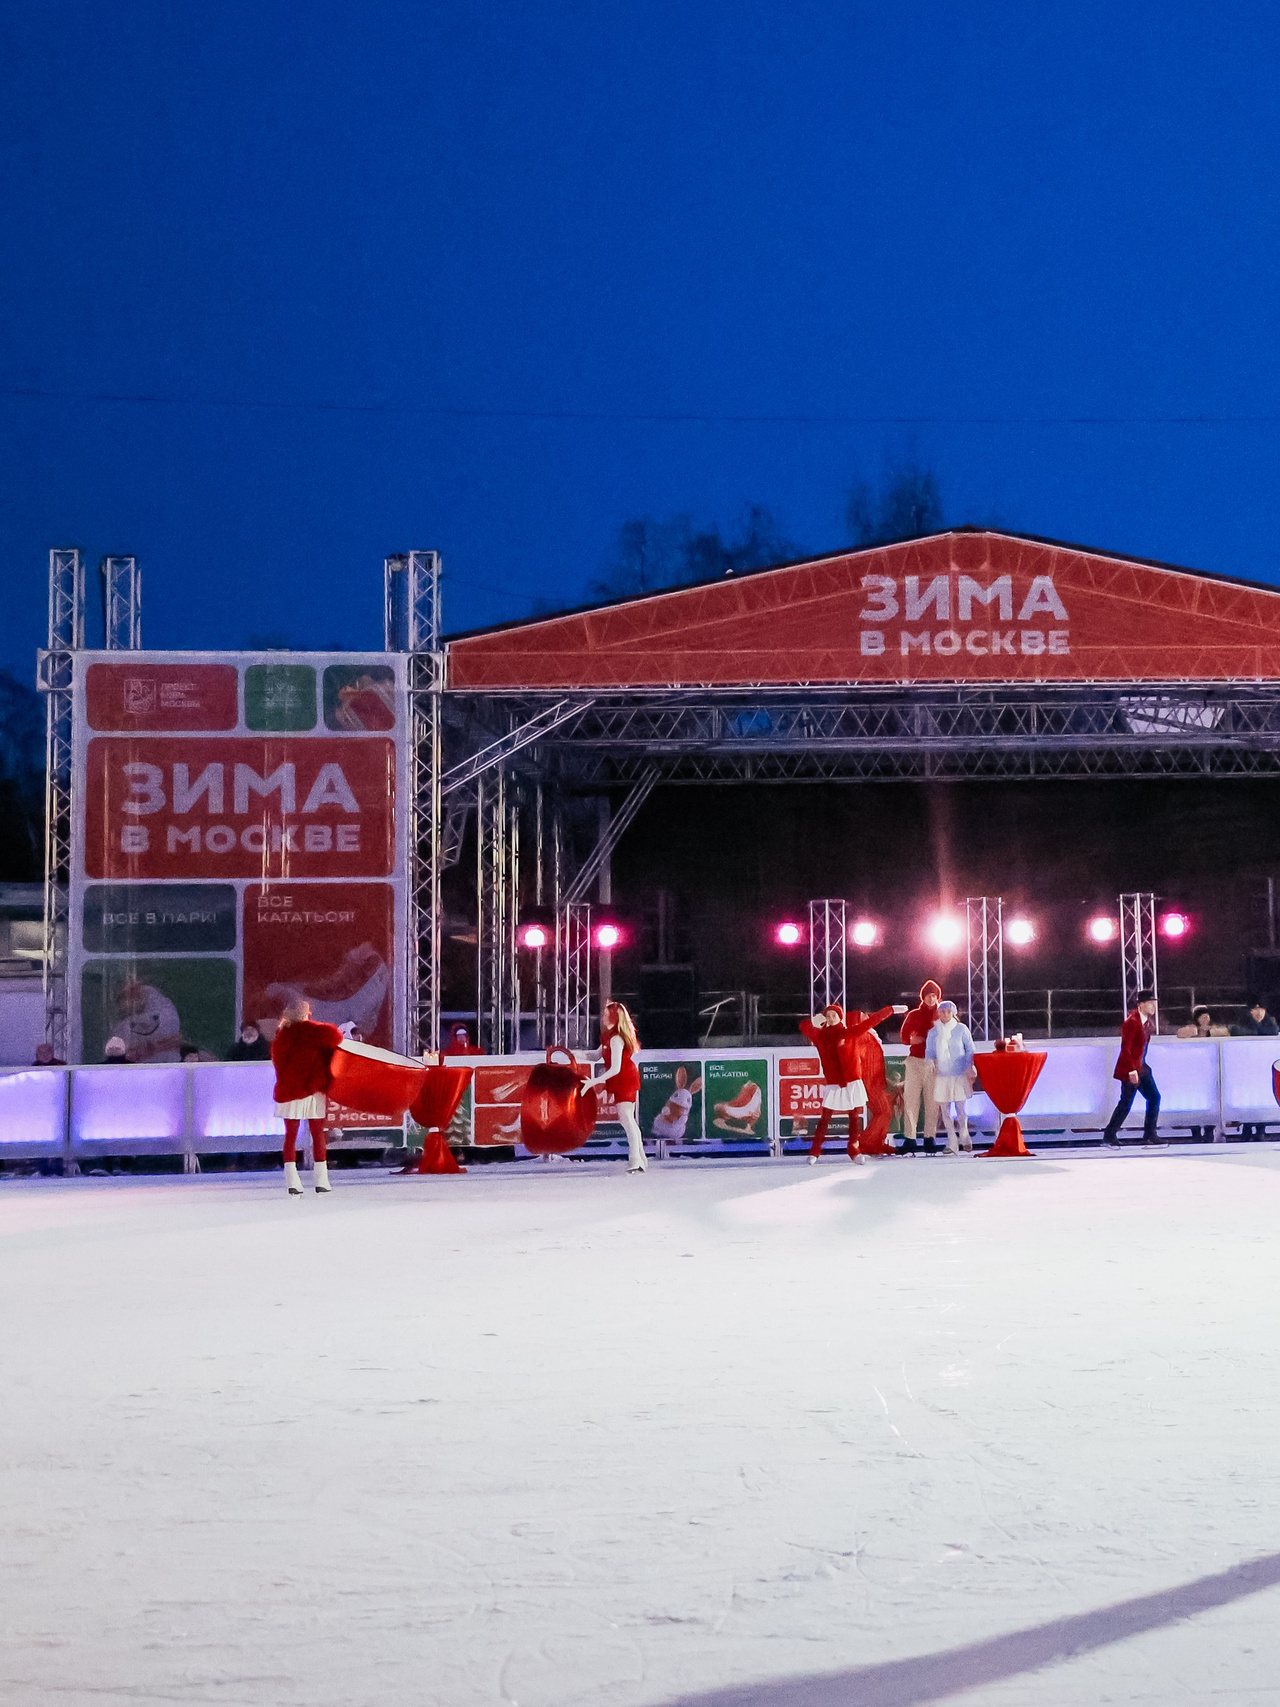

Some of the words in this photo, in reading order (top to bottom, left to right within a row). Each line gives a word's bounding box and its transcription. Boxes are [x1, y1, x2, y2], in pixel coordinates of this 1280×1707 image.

[859, 574, 1069, 622] ЗИМА
[860, 631, 886, 656] В
[900, 630, 1070, 656] МОСКВЕ
[160, 700, 201, 708] МОСКВЫ
[121, 762, 360, 815] ЗИМА
[120, 826, 149, 853] В
[166, 824, 361, 853] МОСКВЕ
[257, 896, 293, 908] ВСЕ
[103, 912, 139, 926] ВСЕ
[145, 912, 157, 925] В
[162, 911, 217, 924] ПАРК!
[257, 910, 355, 923] КАТАТЬСЯ!
